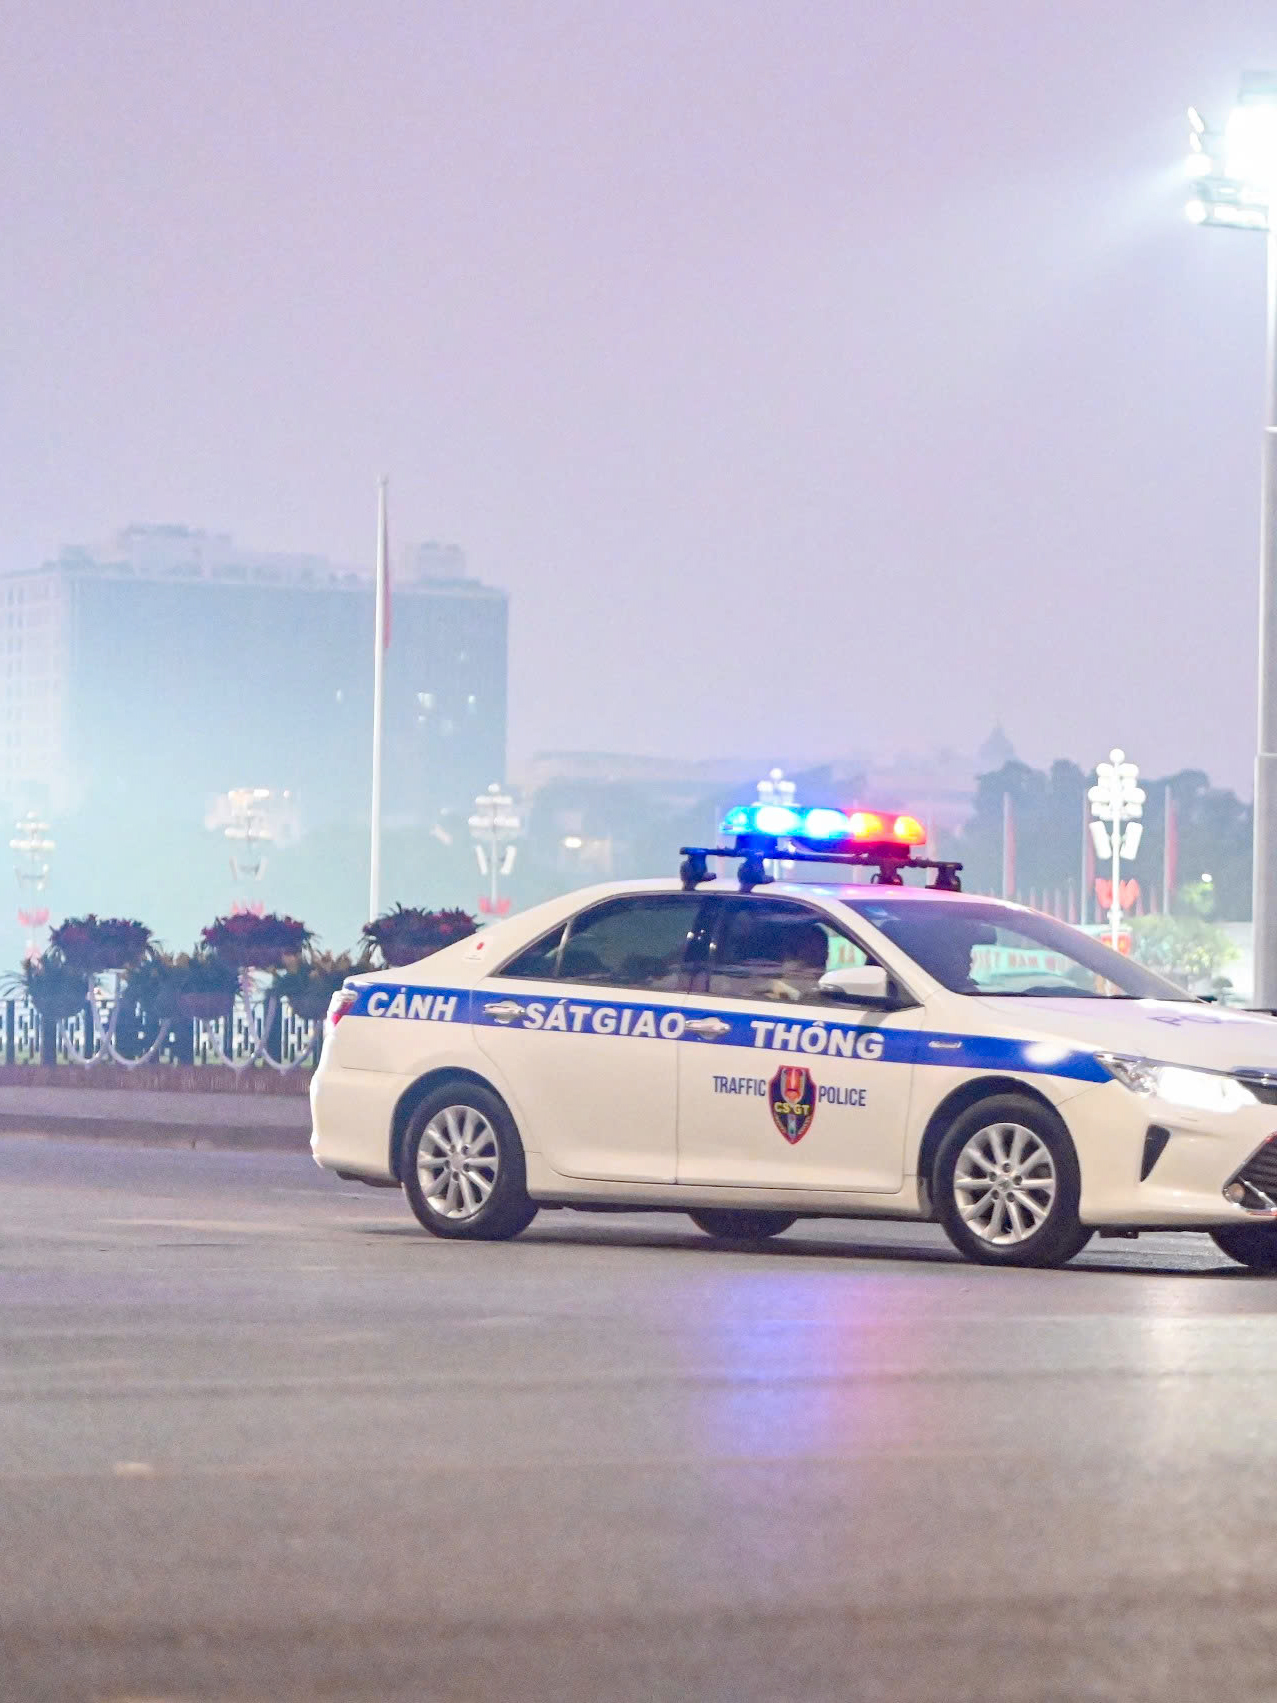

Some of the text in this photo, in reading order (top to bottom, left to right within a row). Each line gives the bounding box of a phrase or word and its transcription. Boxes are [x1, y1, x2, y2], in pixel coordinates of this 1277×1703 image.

[750, 1019, 886, 1061] THÔNG
[713, 1075, 867, 1107] TRAFFIC POLICE
